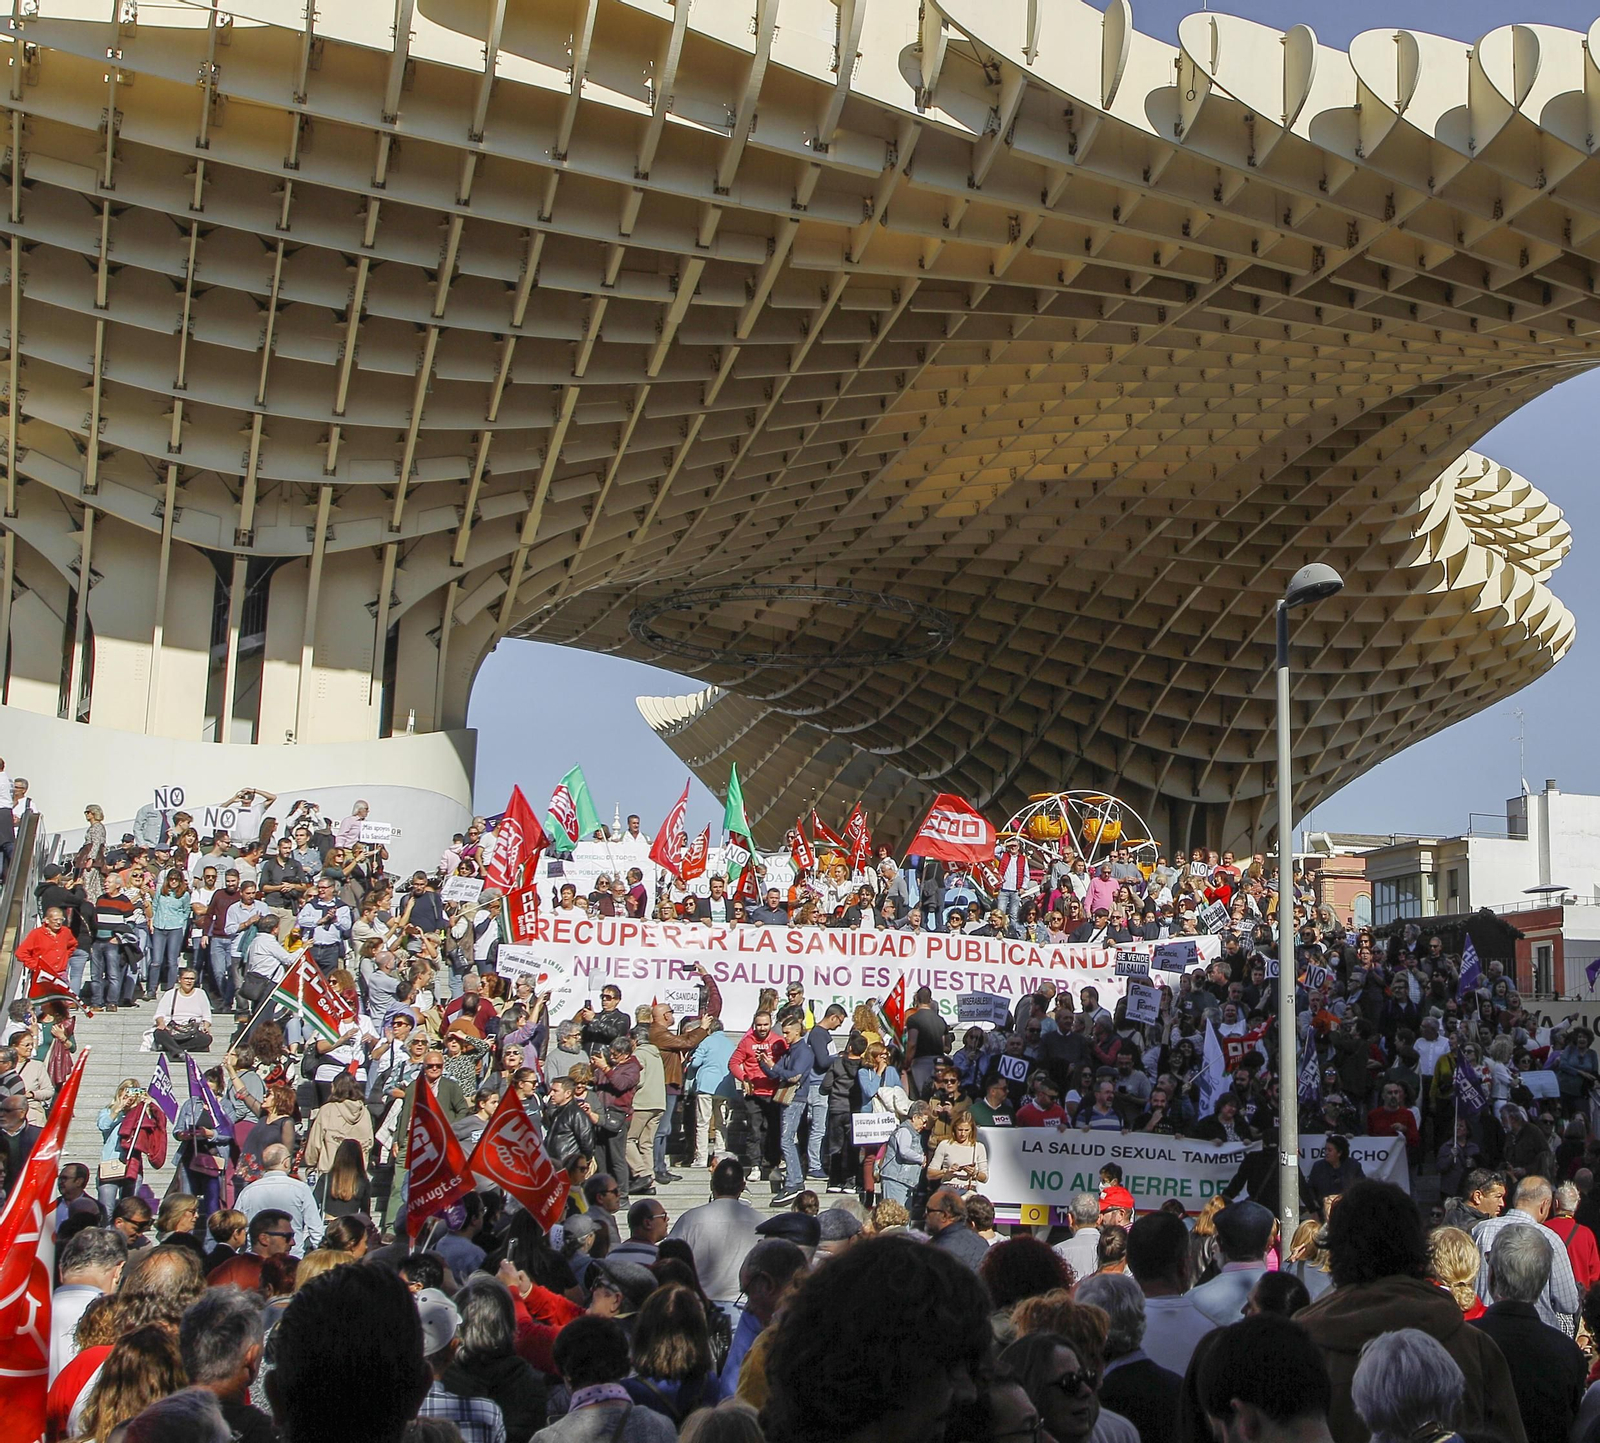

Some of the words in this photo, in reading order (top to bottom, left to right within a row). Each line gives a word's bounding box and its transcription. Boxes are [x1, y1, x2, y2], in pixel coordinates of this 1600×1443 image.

[154, 787, 184, 809] NO
[204, 806, 236, 829] NO
[727, 846, 748, 865] NO
[1191, 862, 1206, 875] NO
[537, 918, 728, 951] RECUPERAR
[738, 928, 778, 953] LA
[785, 930, 916, 958] SANIDAD
[1117, 952, 1126, 960] SE
[1127, 953, 1150, 963] VENDE
[1117, 962, 1126, 971] TU
[713, 961, 804, 985] SALUD
[814, 965, 852, 988] NO
[861, 966, 890, 988] ES
[898, 967, 1014, 995] VUESTRA
[1304, 965, 1326, 988] NO
[675, 992, 698, 1001] SANIDAD
[1000, 1057, 1026, 1080] NO
[500, 1116, 553, 1172] UGT
[1021, 1140, 1044, 1153] LA
[1048, 1141, 1106, 1157] SALUD
[1110, 1145, 1177, 1161] SEXUAL
[1030, 1170, 1064, 1191] NO
[1125, 1175, 1194, 1197] IERRE
